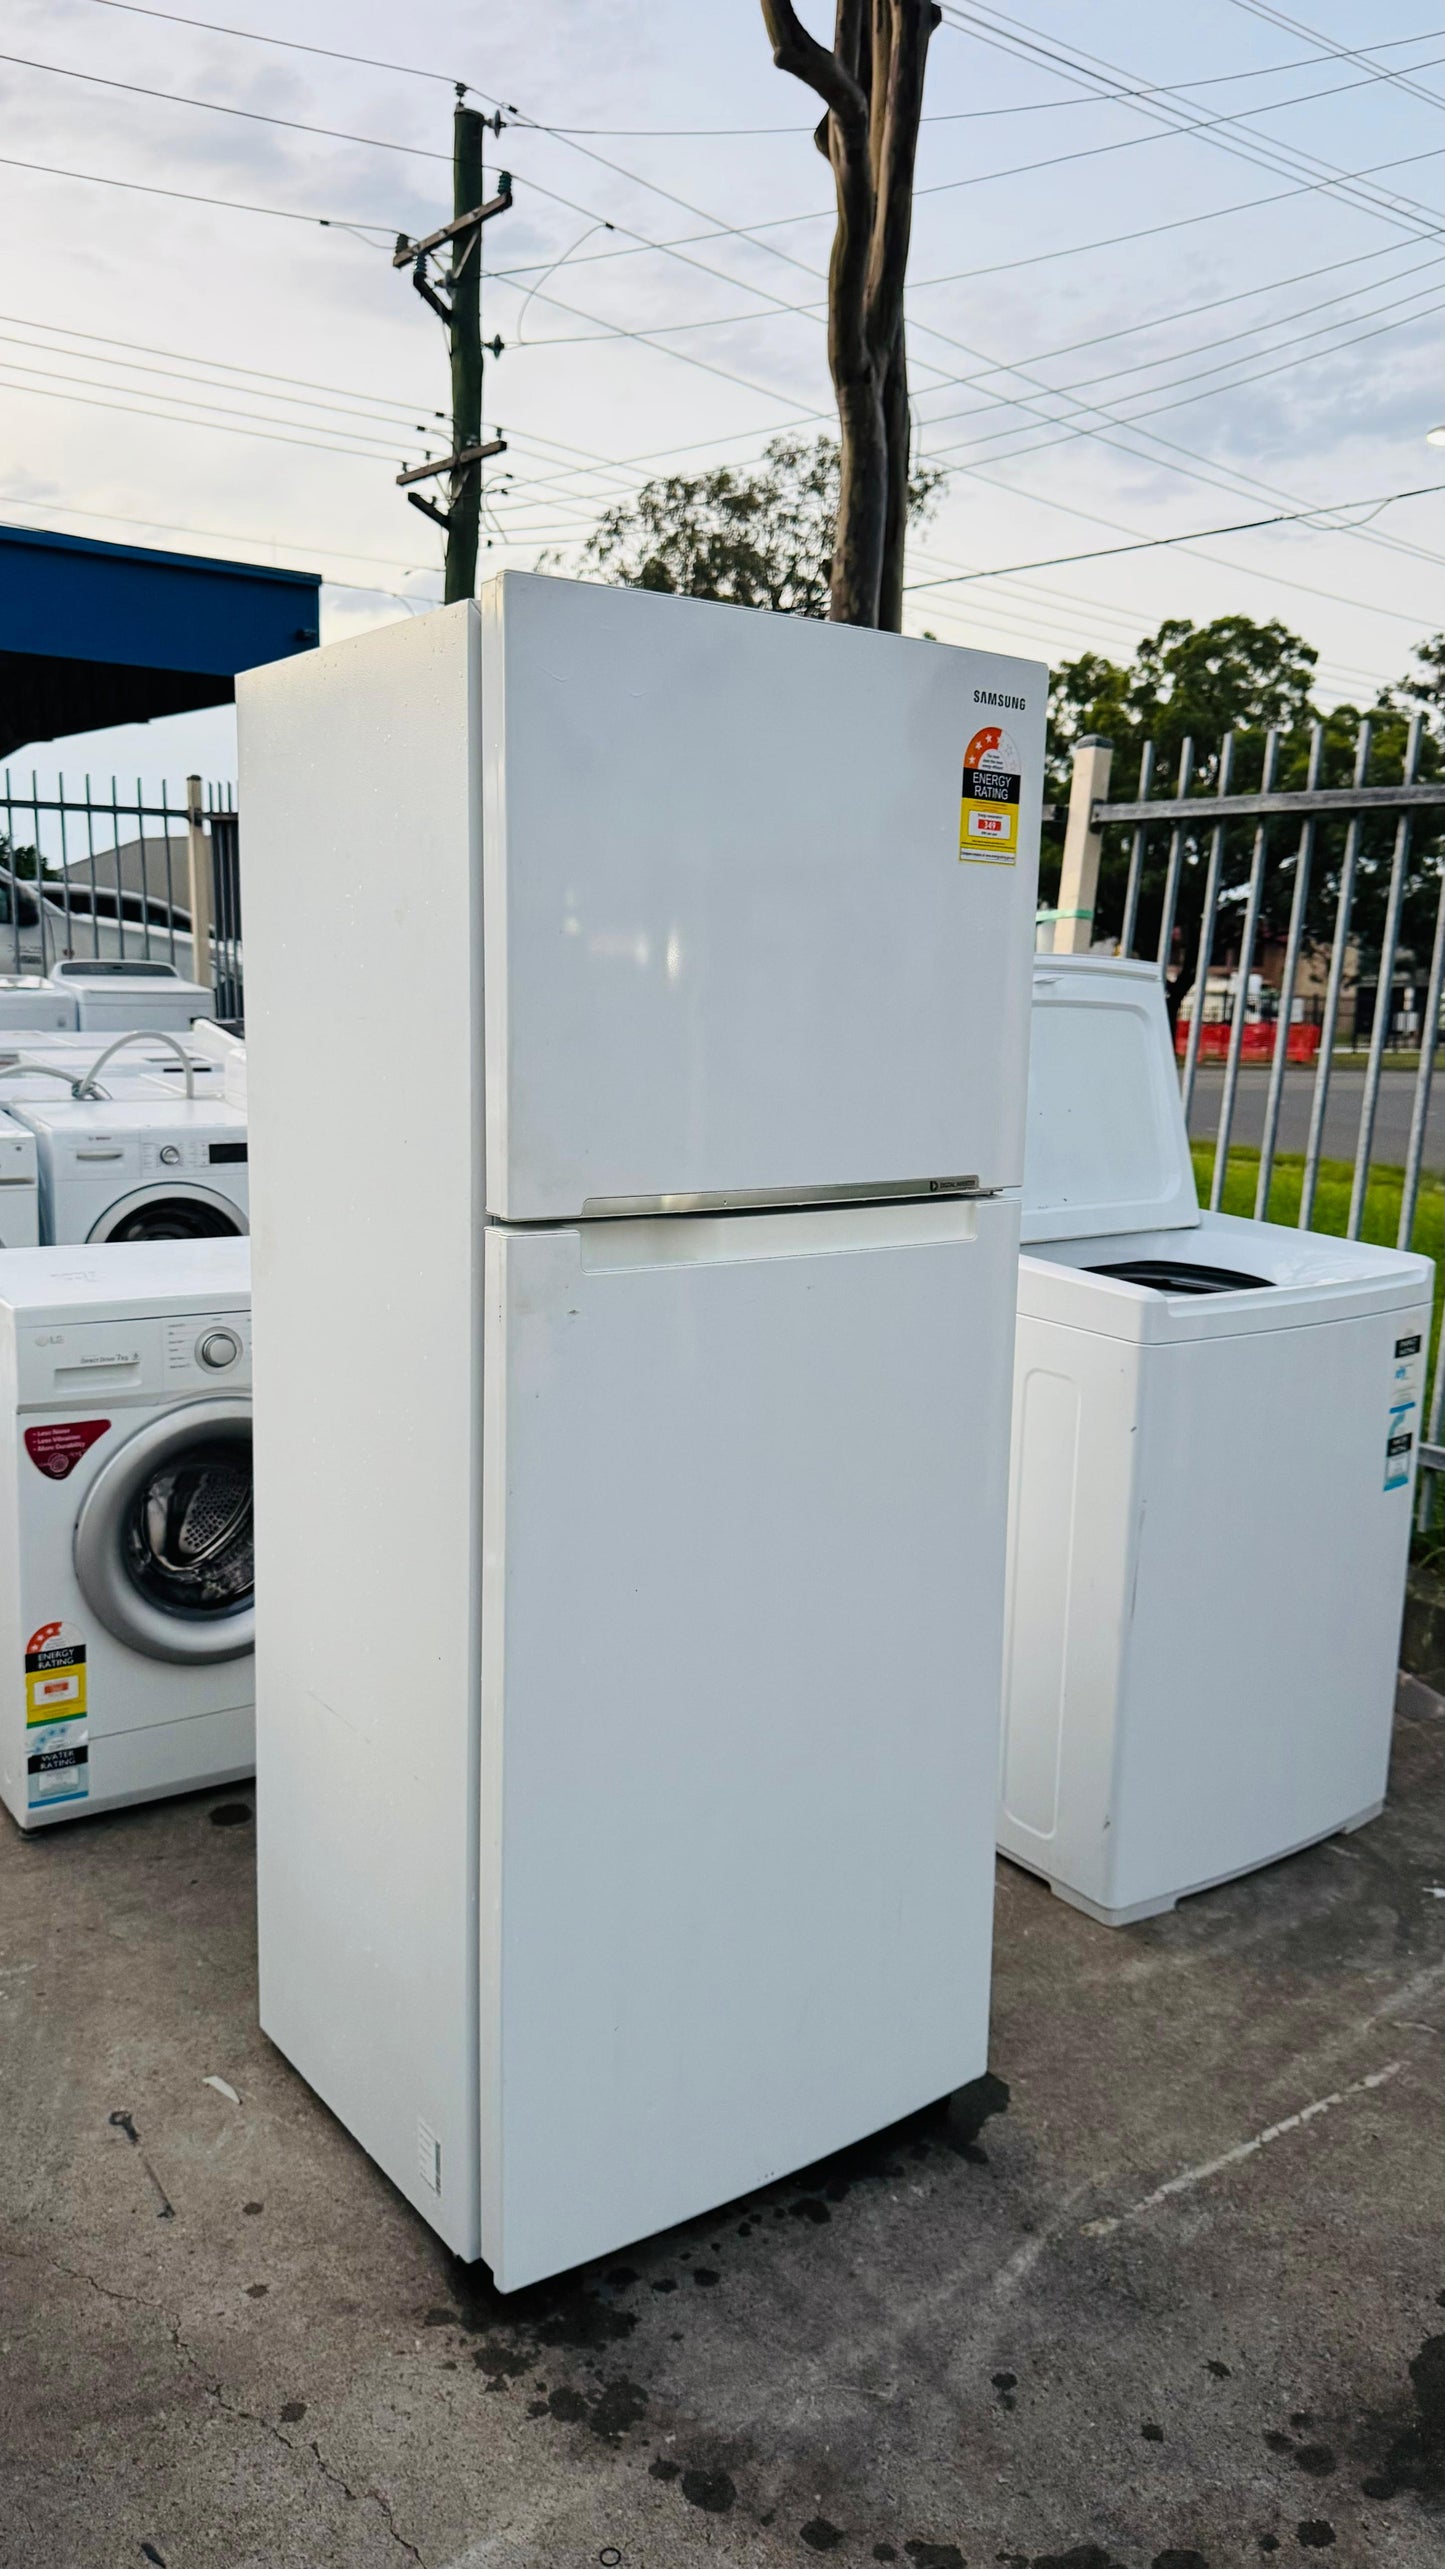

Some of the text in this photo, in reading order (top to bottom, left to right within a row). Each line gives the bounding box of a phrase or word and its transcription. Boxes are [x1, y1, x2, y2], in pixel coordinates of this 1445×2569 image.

[974, 690, 1026, 711] SAMSUNG
[973, 772, 1011, 788] ENERGY
[974, 786, 1009, 800] RATING
[38, 1648, 74, 1661] ENERGY
[38, 1657, 74, 1669] RATING
[42, 1750, 74, 1761] WATER
[40, 1758, 76, 1770] RATING
